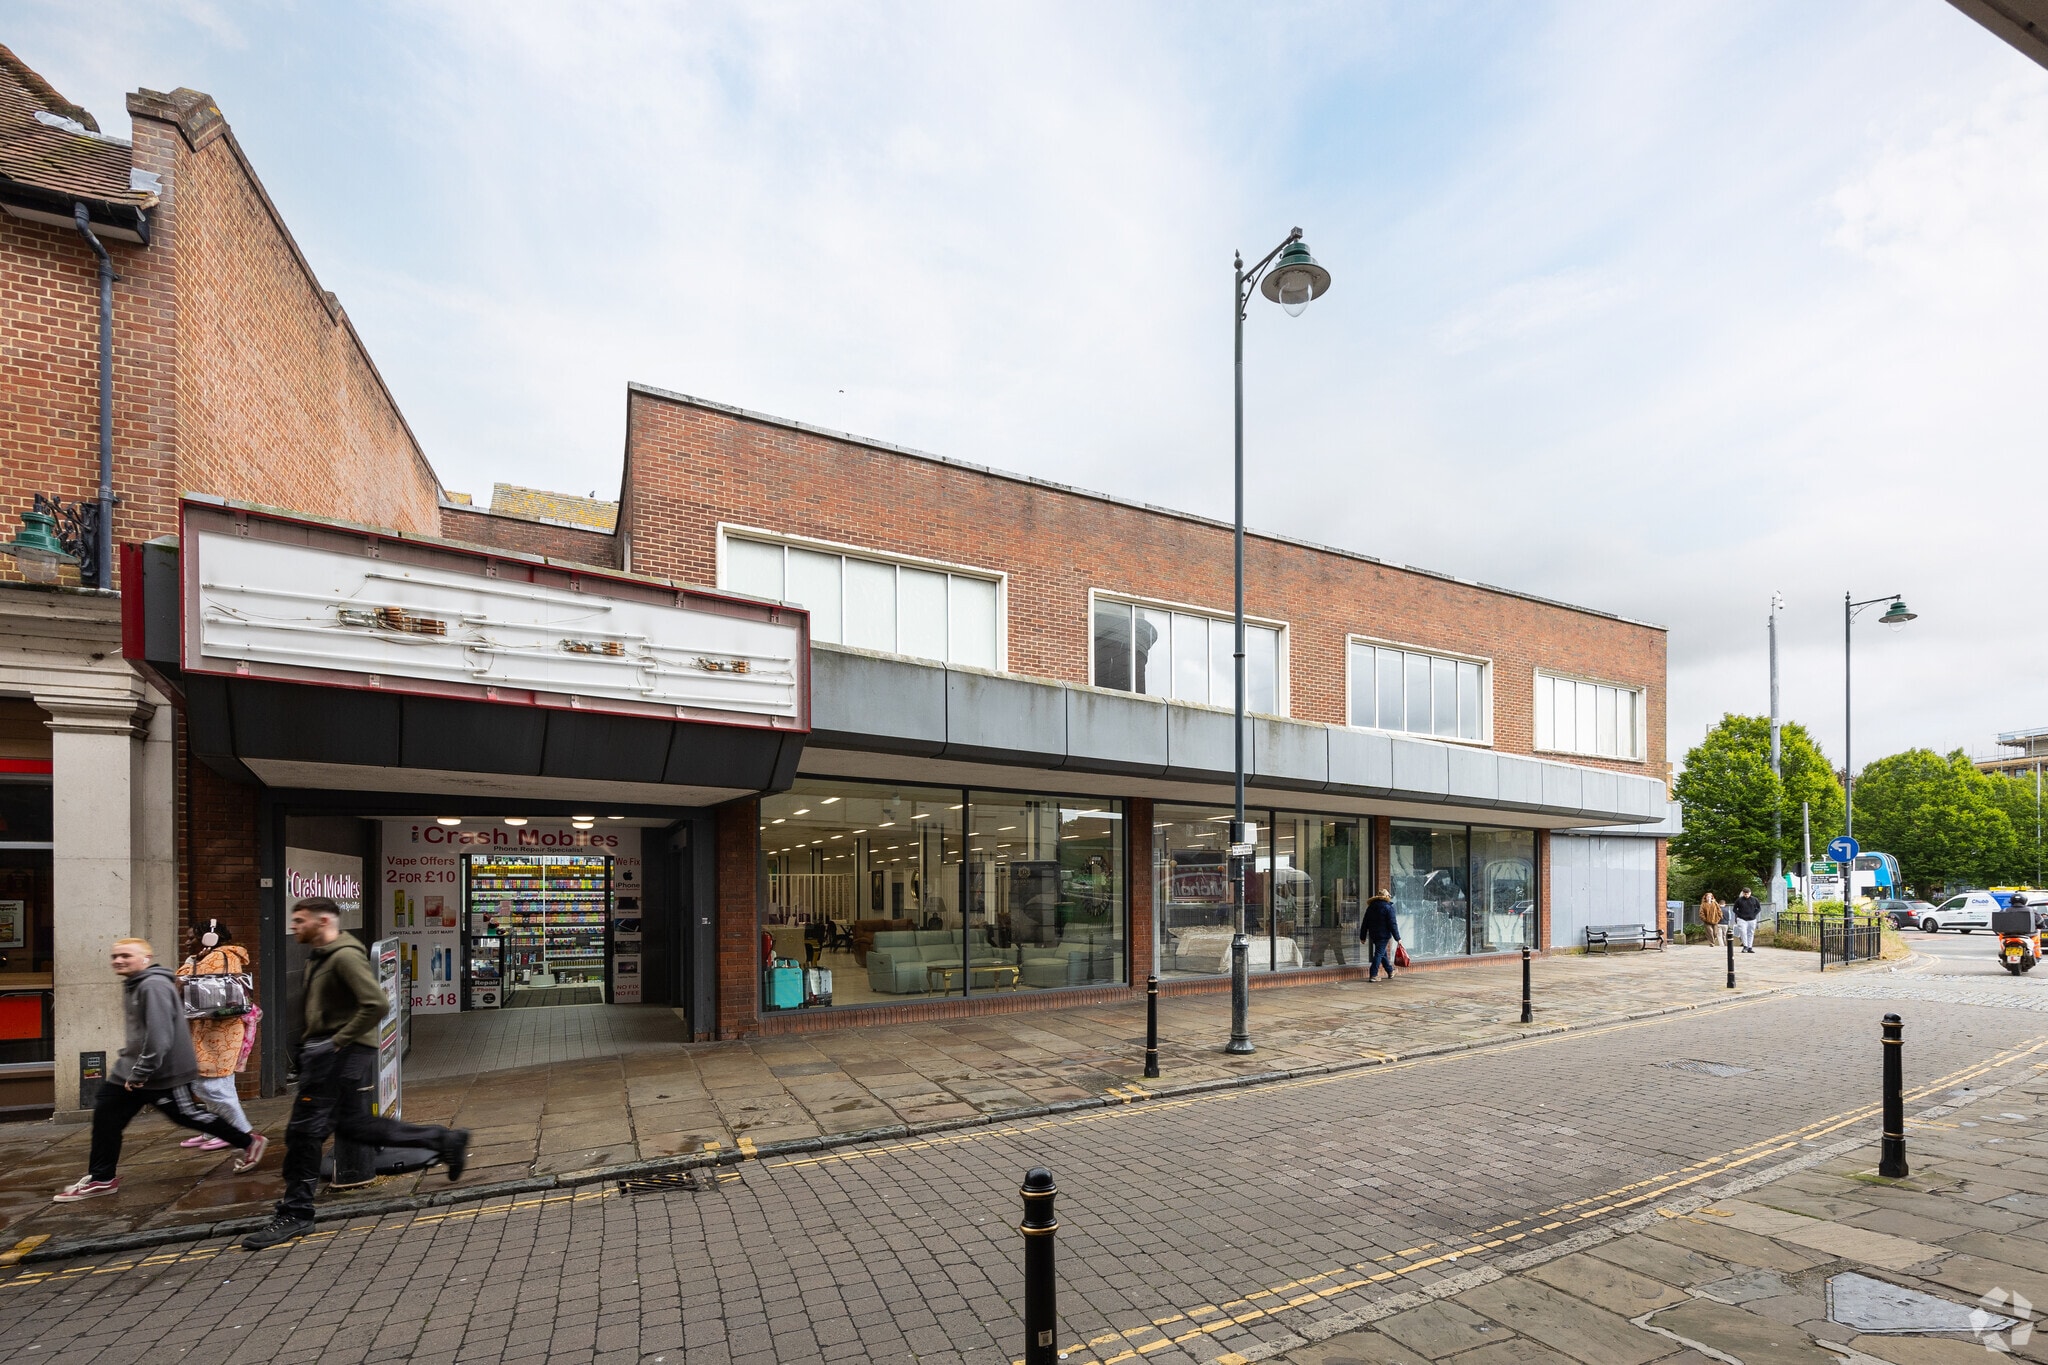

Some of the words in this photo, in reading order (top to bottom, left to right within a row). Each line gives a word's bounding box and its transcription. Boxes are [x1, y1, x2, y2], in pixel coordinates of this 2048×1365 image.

[424, 826, 508, 845] Crash
[518, 829, 619, 847] Mobiles
[387, 856, 416, 867] Vape
[420, 856, 455, 866] Offers
[616, 857, 628, 866] We
[630, 857, 641, 866] Fix
[425, 870, 456, 883] £10
[291, 871, 323, 898] Crash
[324, 874, 361, 899] Mobiles
[426, 993, 457, 1006] £18
